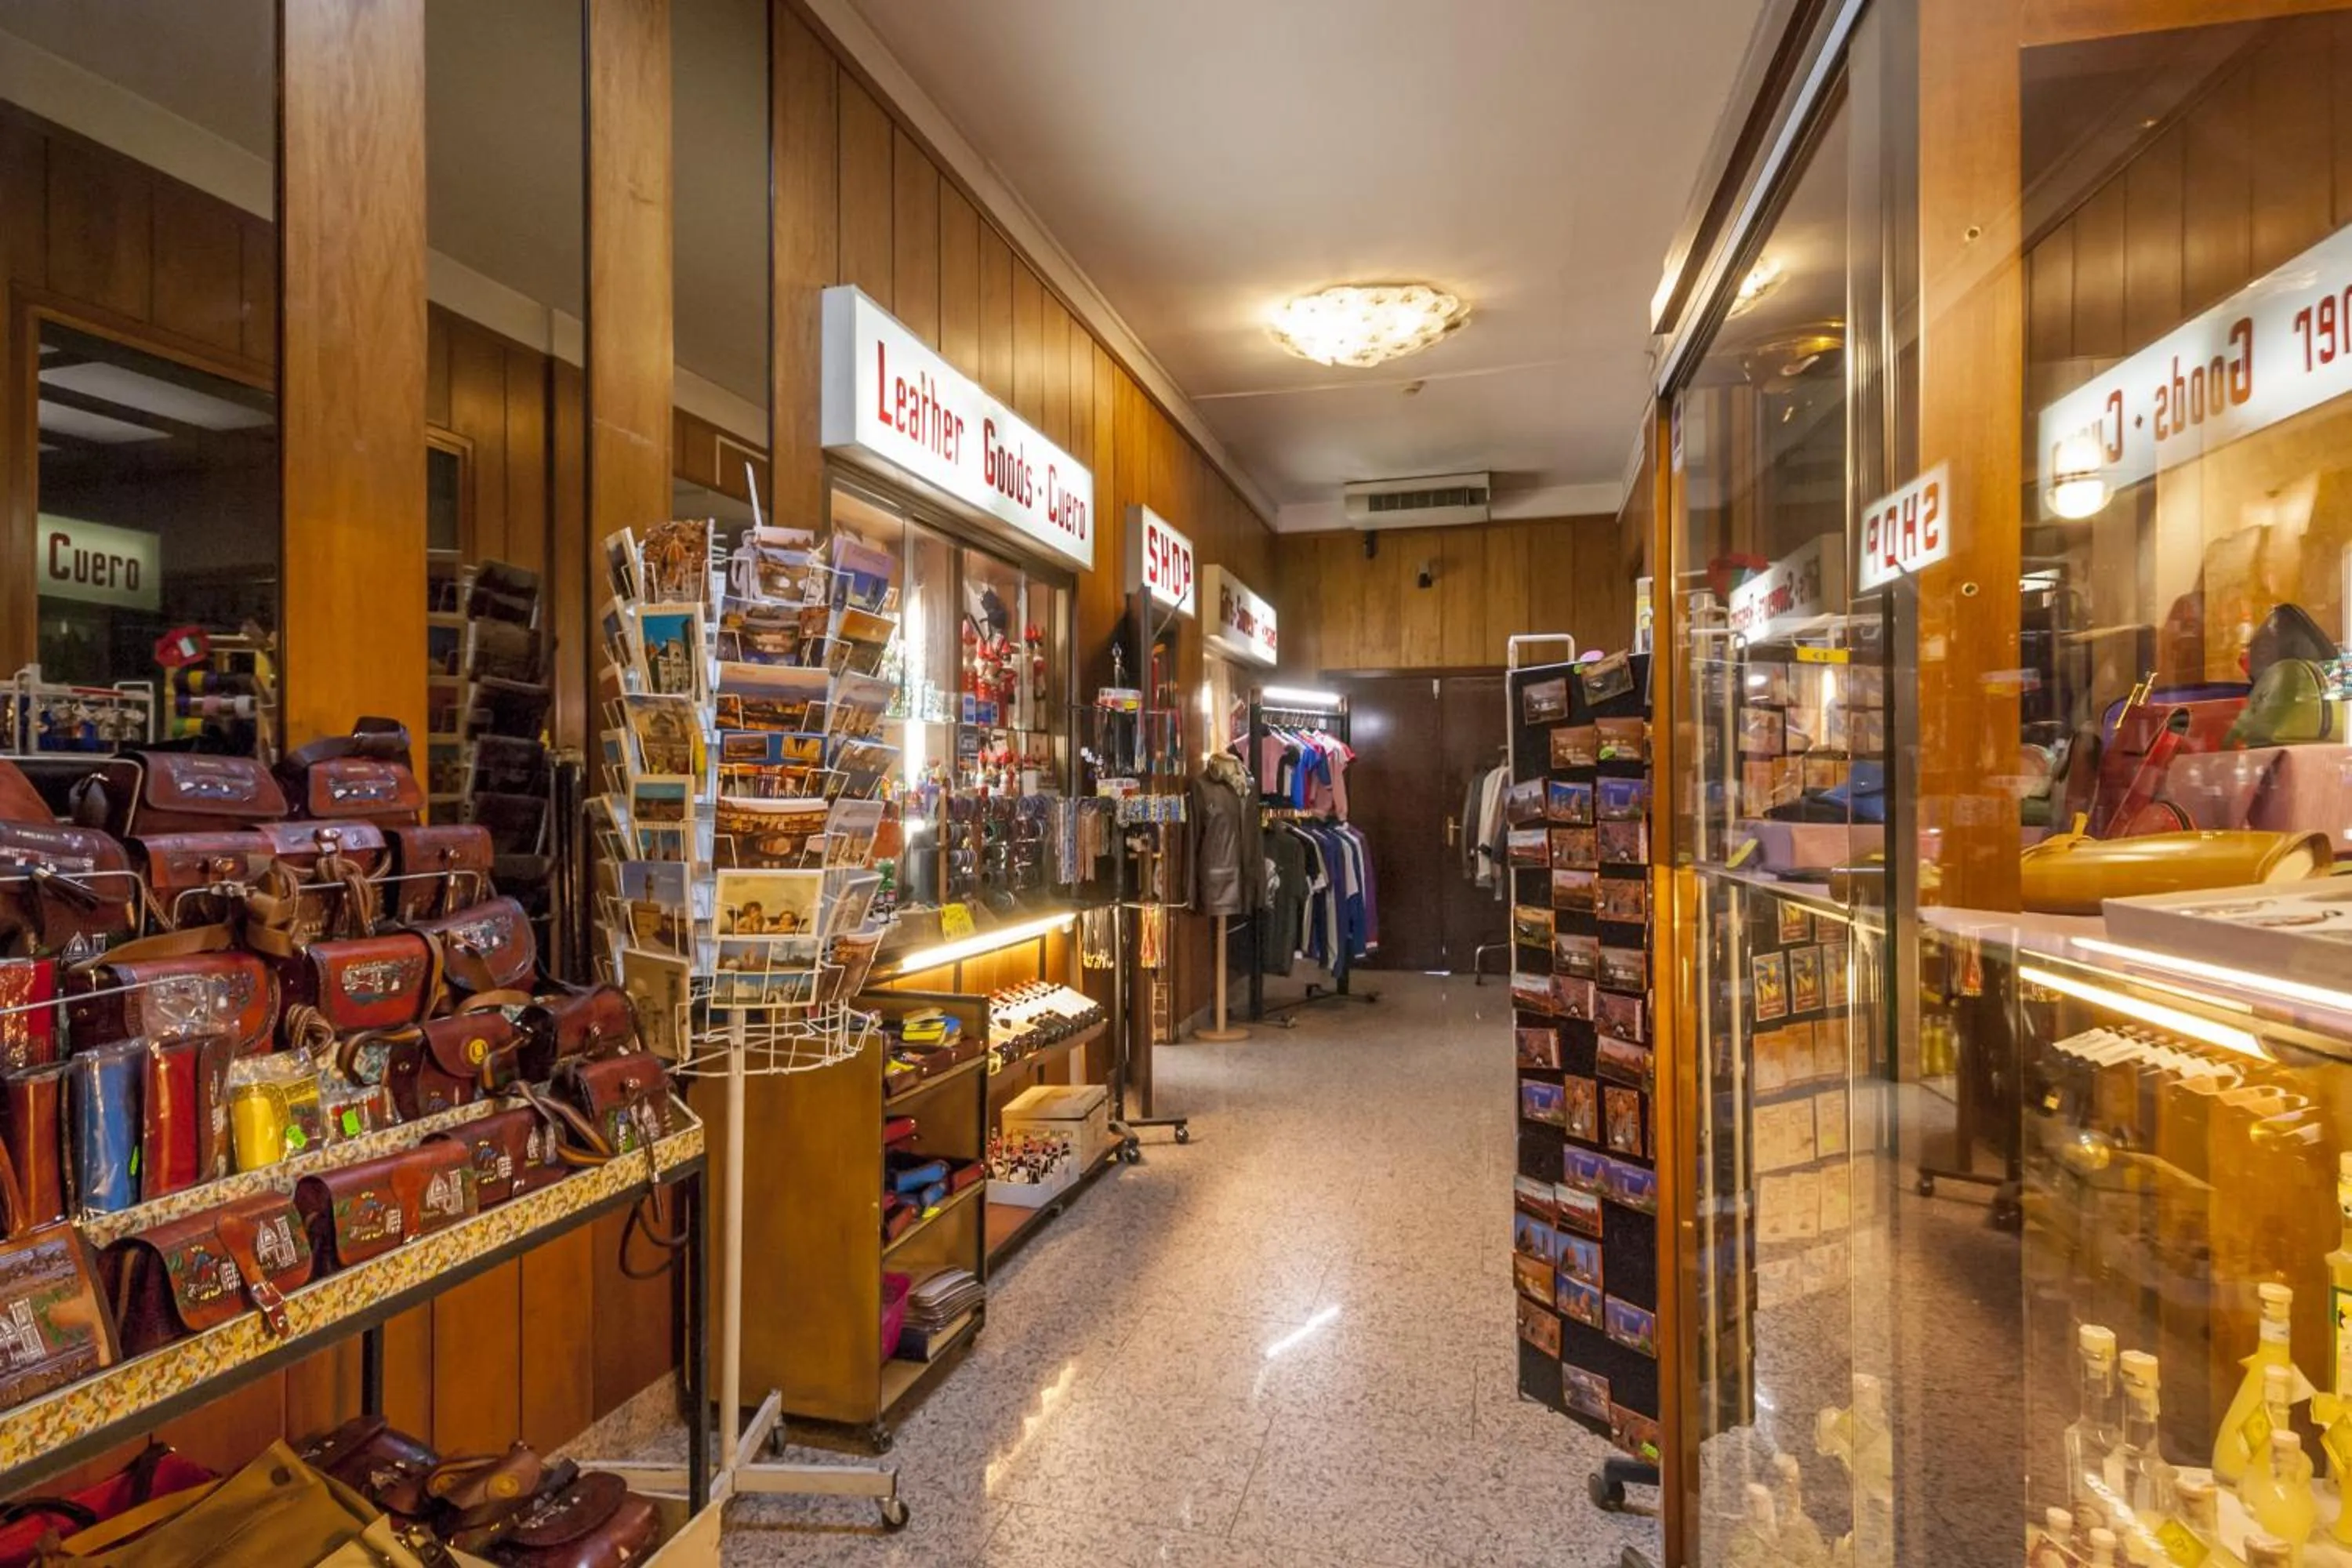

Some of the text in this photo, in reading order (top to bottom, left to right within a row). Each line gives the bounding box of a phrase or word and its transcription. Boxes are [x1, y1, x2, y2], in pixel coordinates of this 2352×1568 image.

[877, 339, 1086, 540] Leather Goods Cuero
[49, 532, 140, 592] Cuero
[1148, 524, 1191, 597] SHOP
